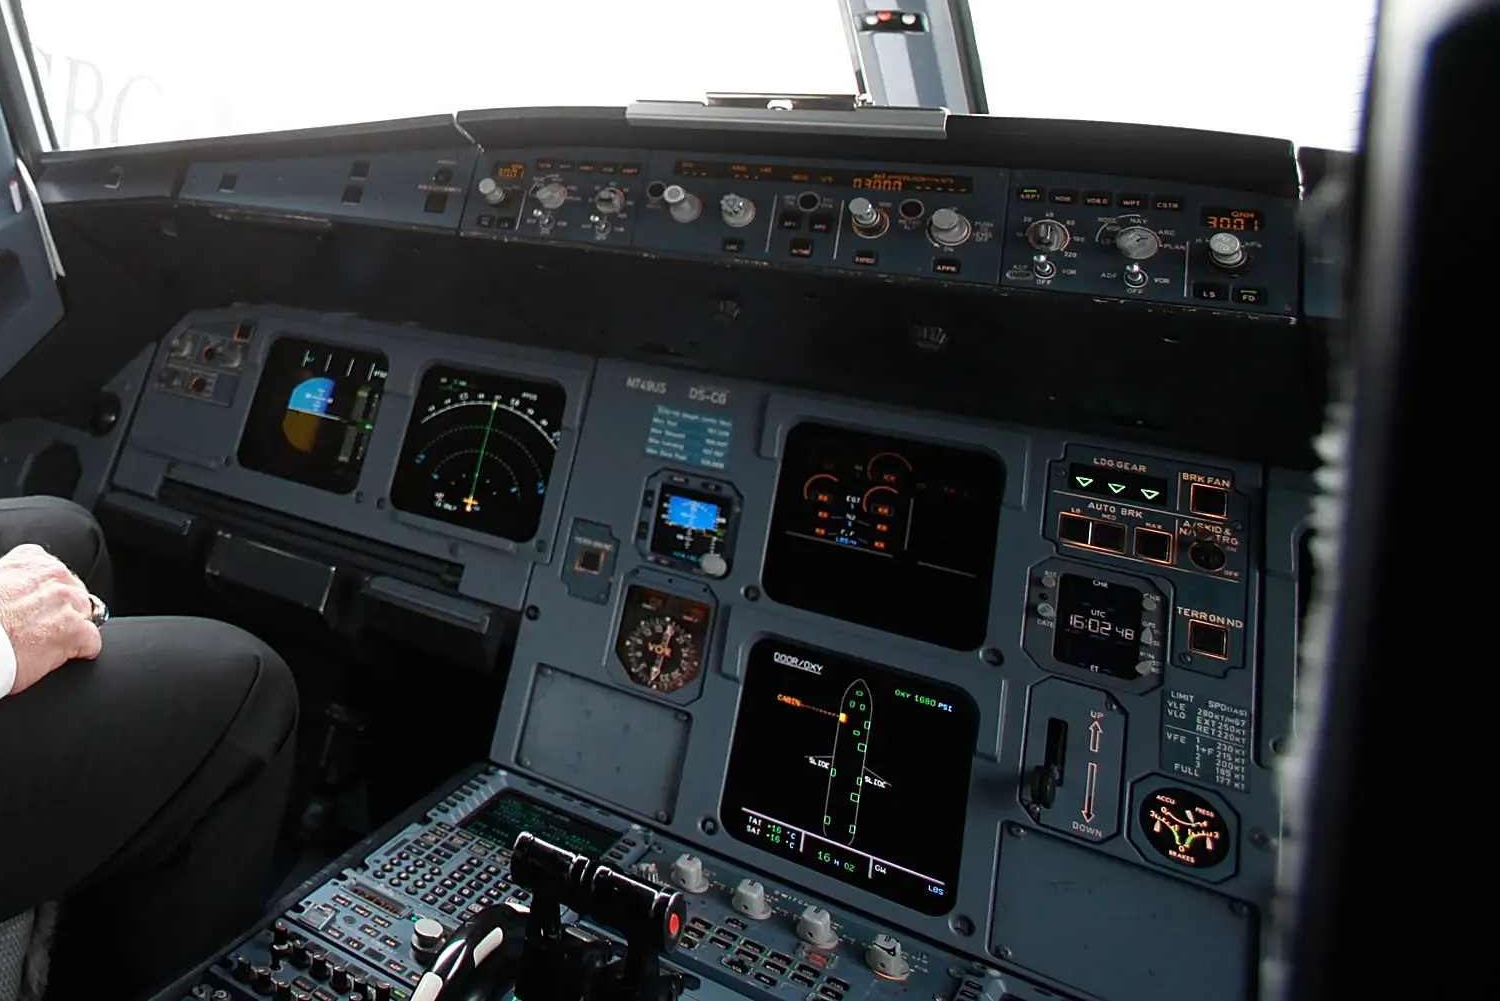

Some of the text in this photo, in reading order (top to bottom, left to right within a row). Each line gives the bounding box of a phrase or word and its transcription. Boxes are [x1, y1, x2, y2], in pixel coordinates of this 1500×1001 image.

[1231, 210, 1256, 219] QNH
[1130, 217, 1149, 225] NAV
[1207, 216, 1261, 232] 3001
[1158, 229, 1177, 237] ARC
[1163, 243, 1187, 251] PLAN
[1036, 278, 1052, 286] OFF
[1100, 272, 1118, 280] ADF
[1154, 277, 1171, 285] VOR
[1202, 290, 1217, 299] LS
[1242, 294, 1257, 302] FD
[1093, 457, 1147, 473] LDG GEAR
[1182, 472, 1231, 488] BRK FAN
[1088, 502, 1144, 519] AUTO BRK
[1101, 513, 1117, 521] MED
[1145, 522, 1163, 530] MAX
[1182, 520, 1222, 534] A/SKID
[1092, 579, 1109, 589] CHR
[1143, 593, 1161, 602] CHR
[1090, 608, 1106, 618] UTC
[1177, 606, 1244, 629] TERR ON ND
[1069, 613, 1135, 641] 16:02 48
[773, 651, 824, 673] DOOR/OXY
[777, 693, 803, 708] CABIN
[894, 688, 953, 713] OXY 1680 PSI
[1170, 691, 1195, 703] LIMIT
[1167, 700, 1185, 711] VLE
[1090, 710, 1104, 718] UP
[1167, 709, 1186, 720] VLO
[1196, 717, 1217, 729] EXT
[1196, 725, 1216, 736] RET
[1166, 732, 1233, 753] VFE 230
[1216, 750, 1232, 761] 215
[808, 756, 830, 770] SLIDE
[1216, 759, 1234, 771] 200
[1174, 762, 1200, 777] FULL
[1155, 794, 1176, 805] ACCU
[1195, 806, 1216, 819] PRESS
[748, 815, 762, 827] TAT
[745, 824, 761, 836] SAT
[1072, 821, 1102, 837] DOWN
[817, 850, 831, 863] 16
[844, 862, 855, 873] 02
[1168, 849, 1196, 863] BRAKES
[874, 863, 887, 875] GW
[927, 884, 944, 896] LBS
